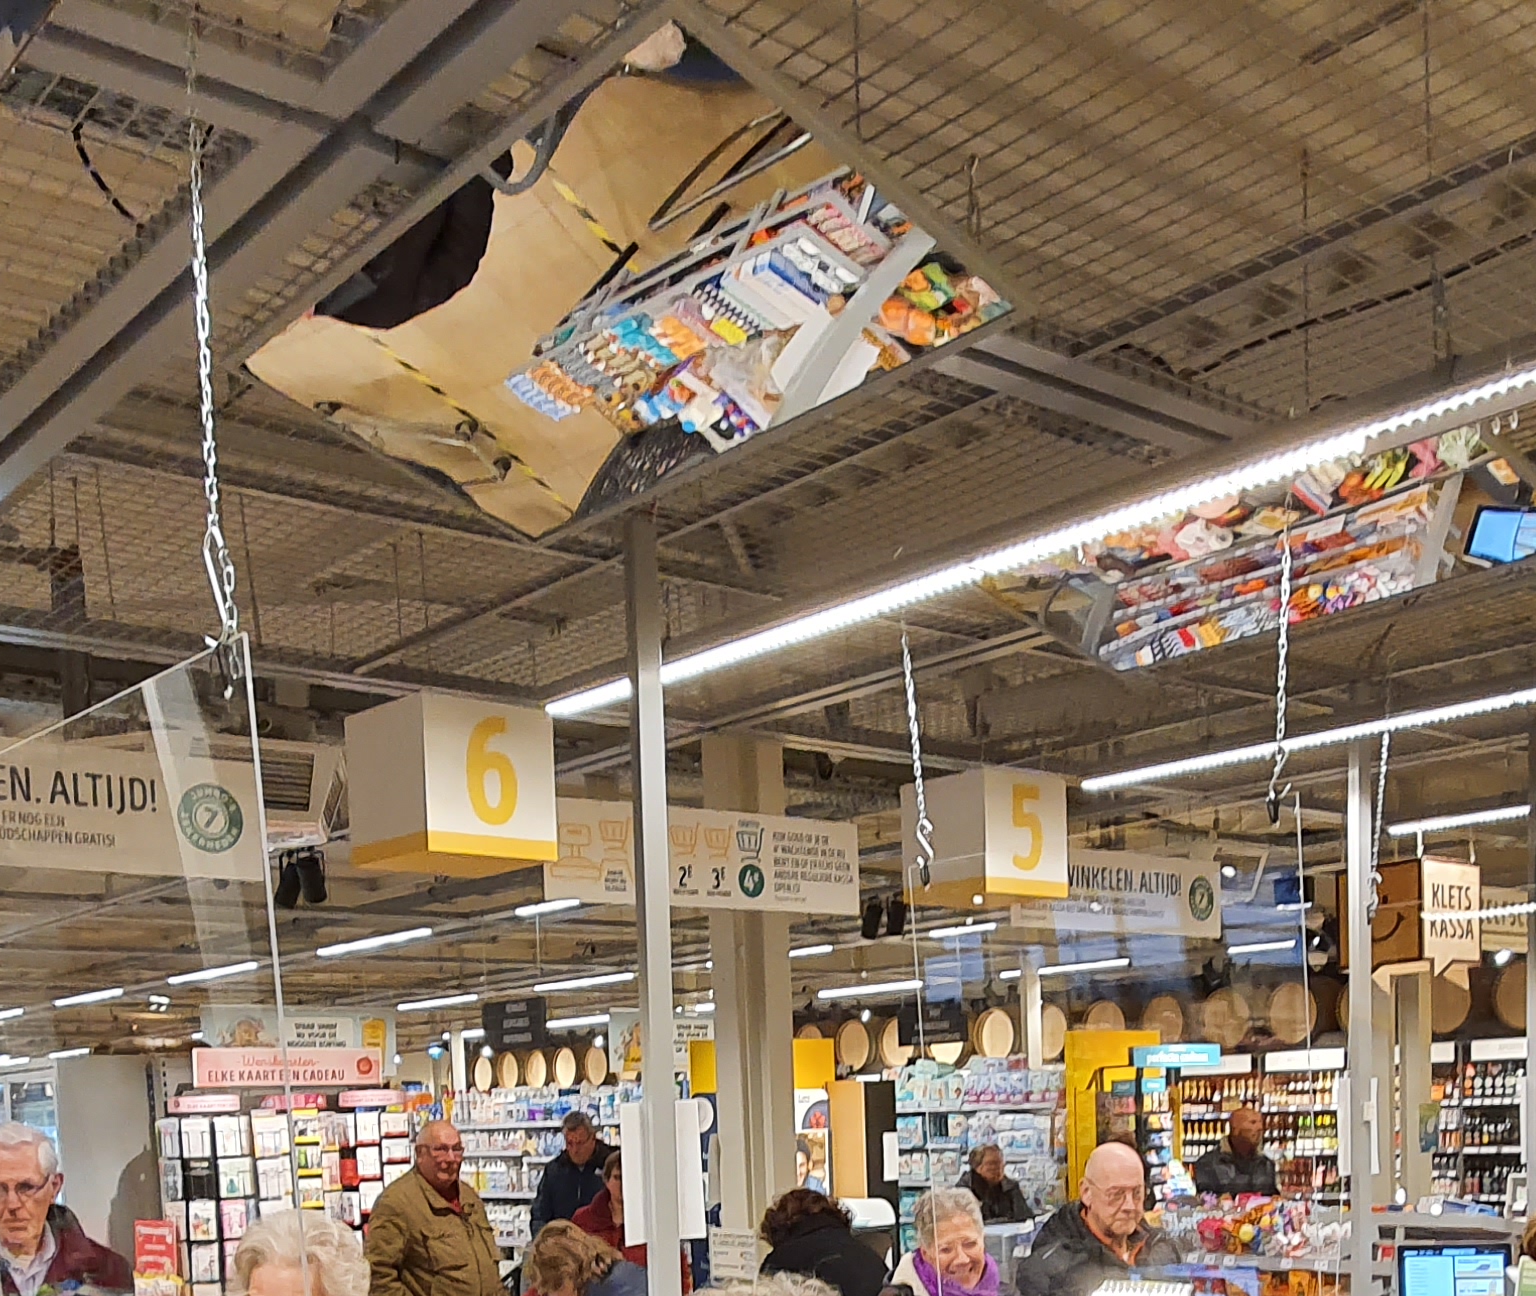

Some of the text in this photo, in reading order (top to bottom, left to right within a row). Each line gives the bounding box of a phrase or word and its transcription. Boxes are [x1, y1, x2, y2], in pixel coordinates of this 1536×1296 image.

[466, 716, 518, 826] 6
[50, 770, 158, 815] ALTIJD!
[1011, 783, 1043, 871] 5
[1139, 872, 1181, 897] ALTIJD!
[1431, 883, 1471, 911] KLETS
[1430, 919, 1474, 940] KASSA
[208, 1070, 235, 1082] ELKE
[239, 1069, 275, 1081] KAART
[303, 1069, 345, 1081] CADEAU
